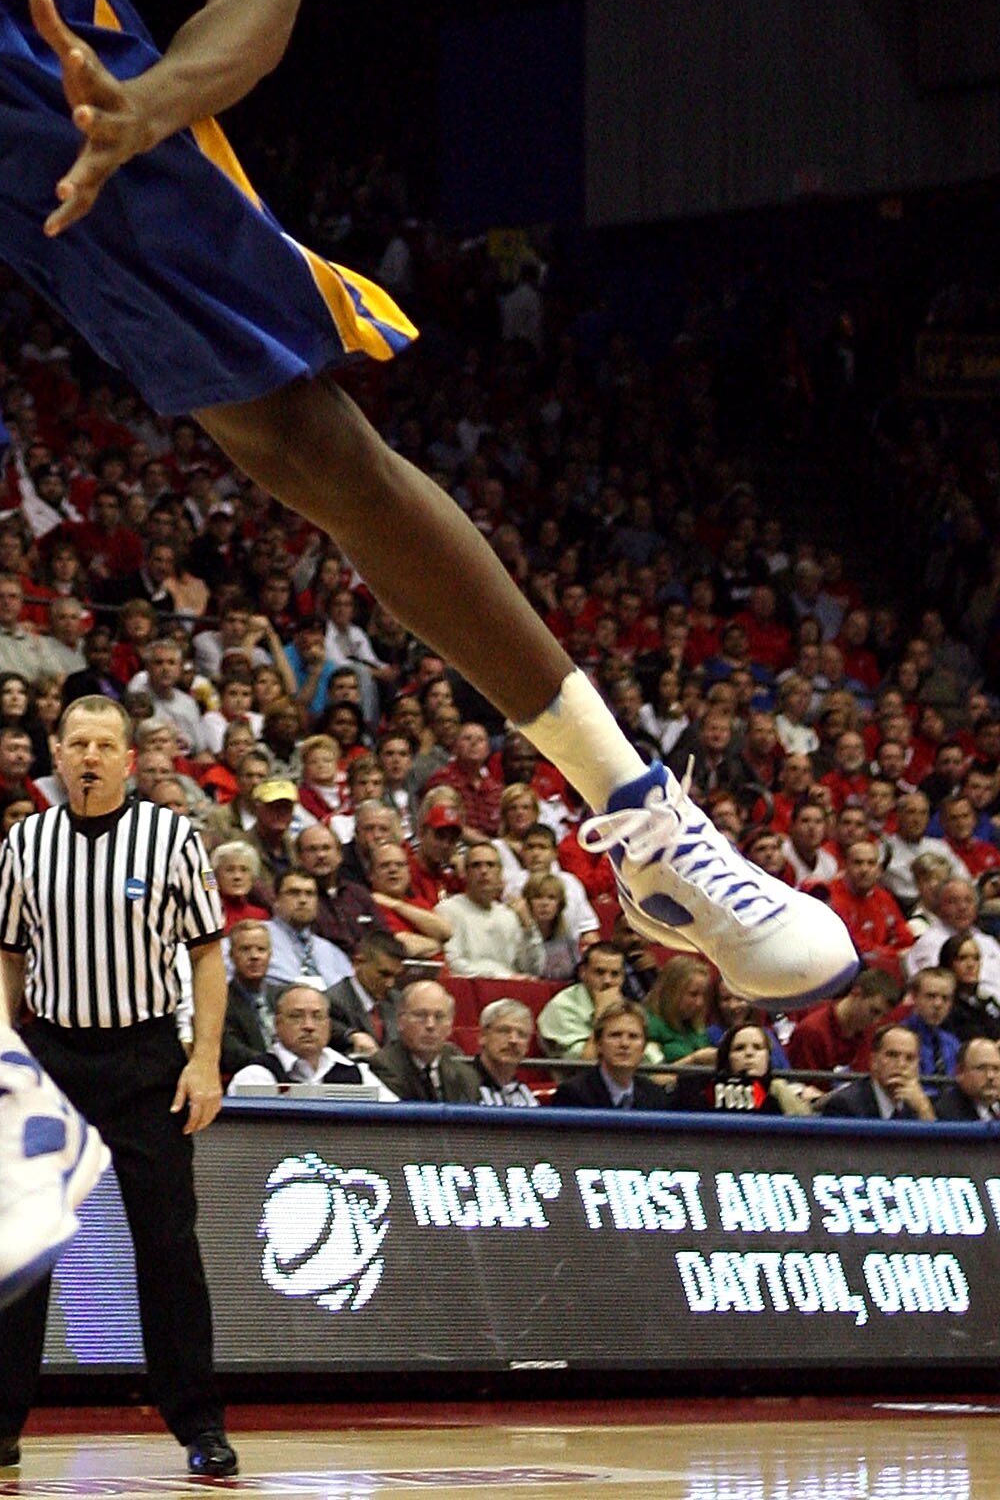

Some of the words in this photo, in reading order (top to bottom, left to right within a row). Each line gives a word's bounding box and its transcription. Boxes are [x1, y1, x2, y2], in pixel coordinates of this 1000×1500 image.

[575, 1168, 708, 1232] FIRST
[714, 1171, 812, 1233] AND
[812, 1174, 988, 1235] SECOND
[675, 1250, 869, 1326] DAYTON,
[862, 1252, 971, 1315] OHIO
